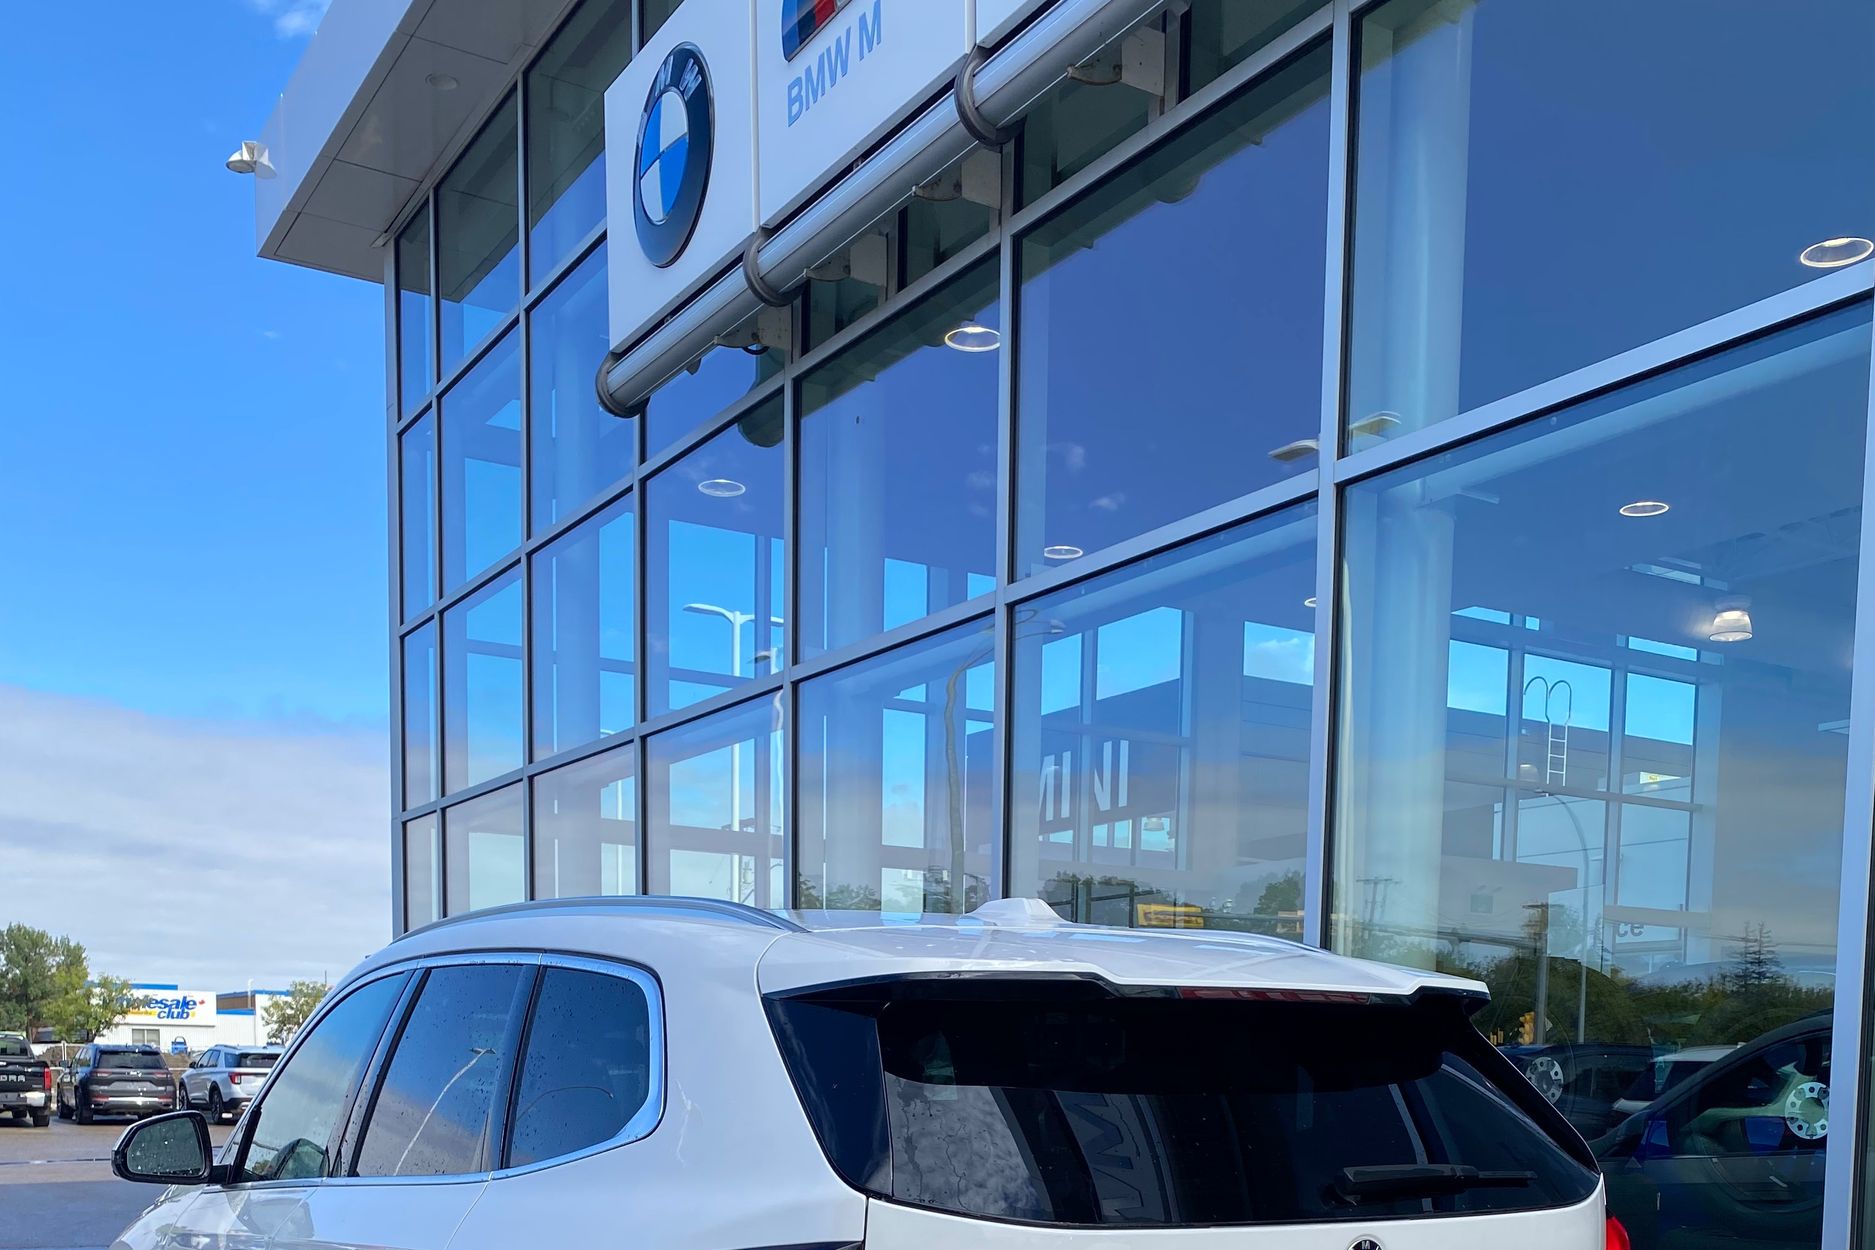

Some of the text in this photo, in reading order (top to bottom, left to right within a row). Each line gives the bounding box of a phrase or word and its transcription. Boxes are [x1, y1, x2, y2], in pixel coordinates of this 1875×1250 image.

[786, 0, 882, 128] BMW M
[157, 1005, 190, 1020] club
